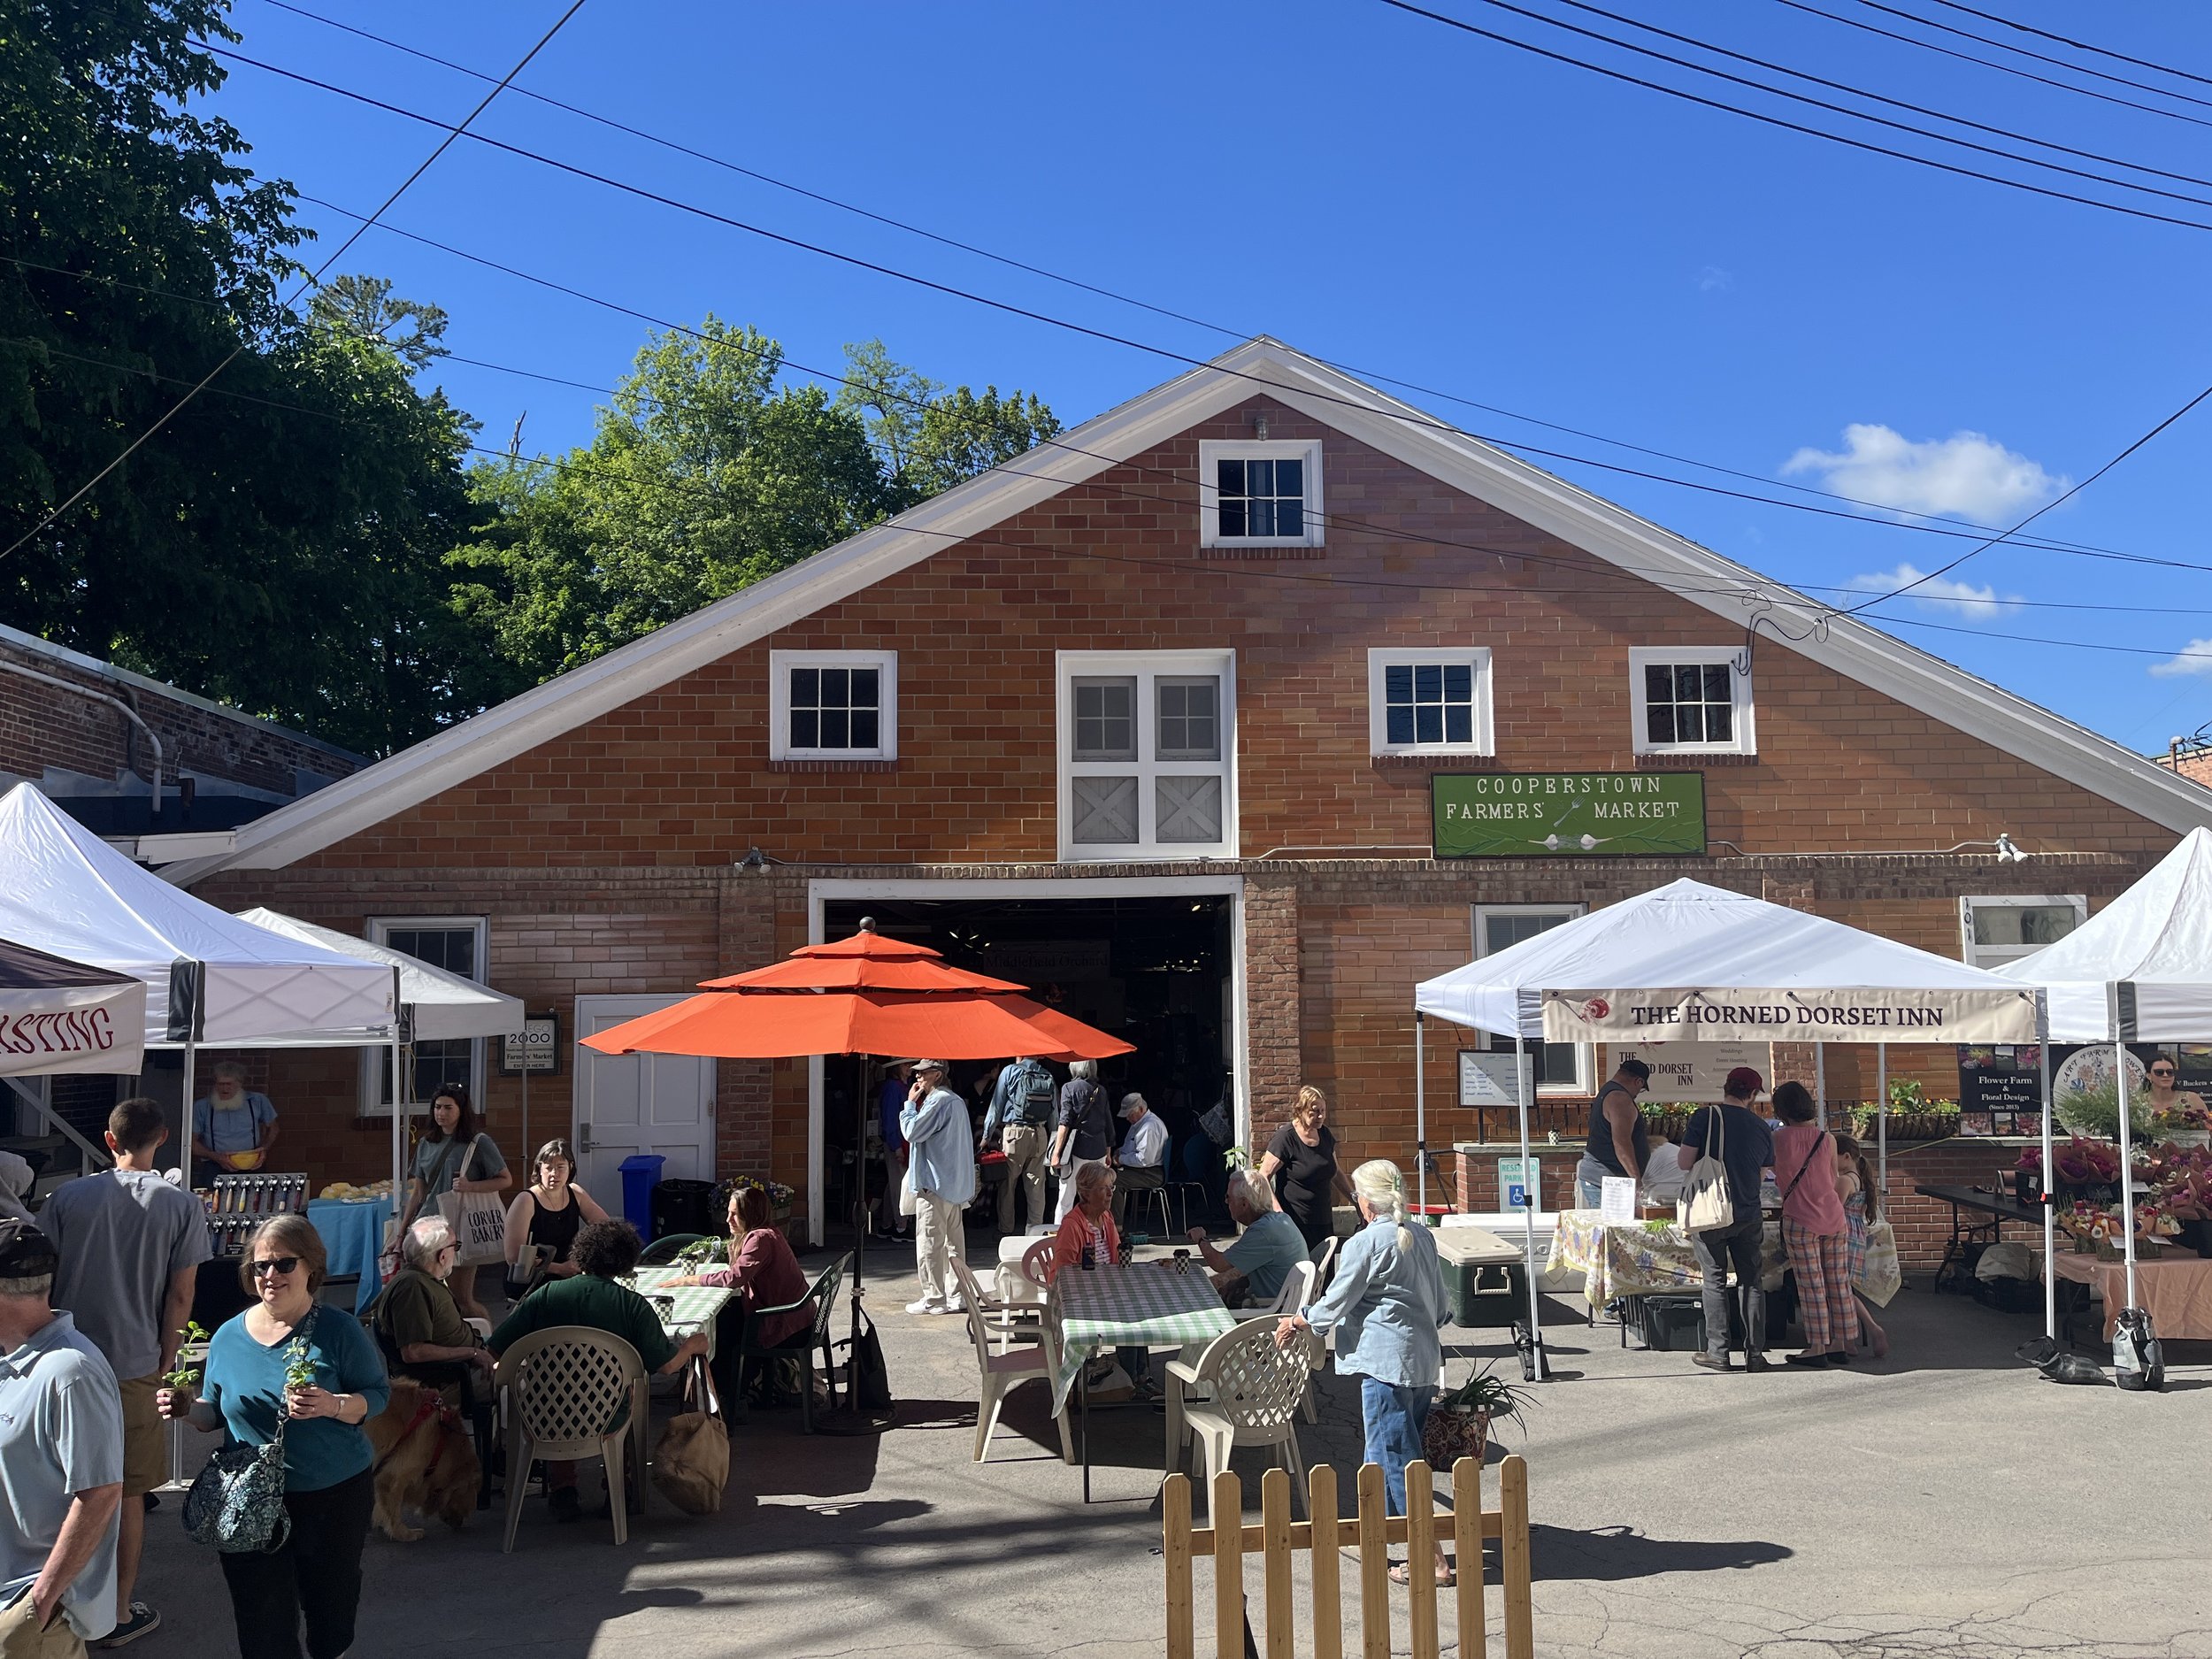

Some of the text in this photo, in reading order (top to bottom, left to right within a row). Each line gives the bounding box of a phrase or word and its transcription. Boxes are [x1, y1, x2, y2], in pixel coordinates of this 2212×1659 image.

[1477, 777, 1661, 795] COOPERSTOWN
[1446, 802, 1679, 819] FARMERS' MARKET
[1631, 1005, 1944, 1026] THE HORNED DORSET INN
[527, 1025, 549, 1033] EGO
[510, 1033, 549, 1043] 2000
[1619, 1051, 1637, 1062] THE
[1658, 1064, 1694, 1074] DORSET
[1677, 1075, 1694, 1086] INN
[2003, 1094, 2030, 1102] Design
